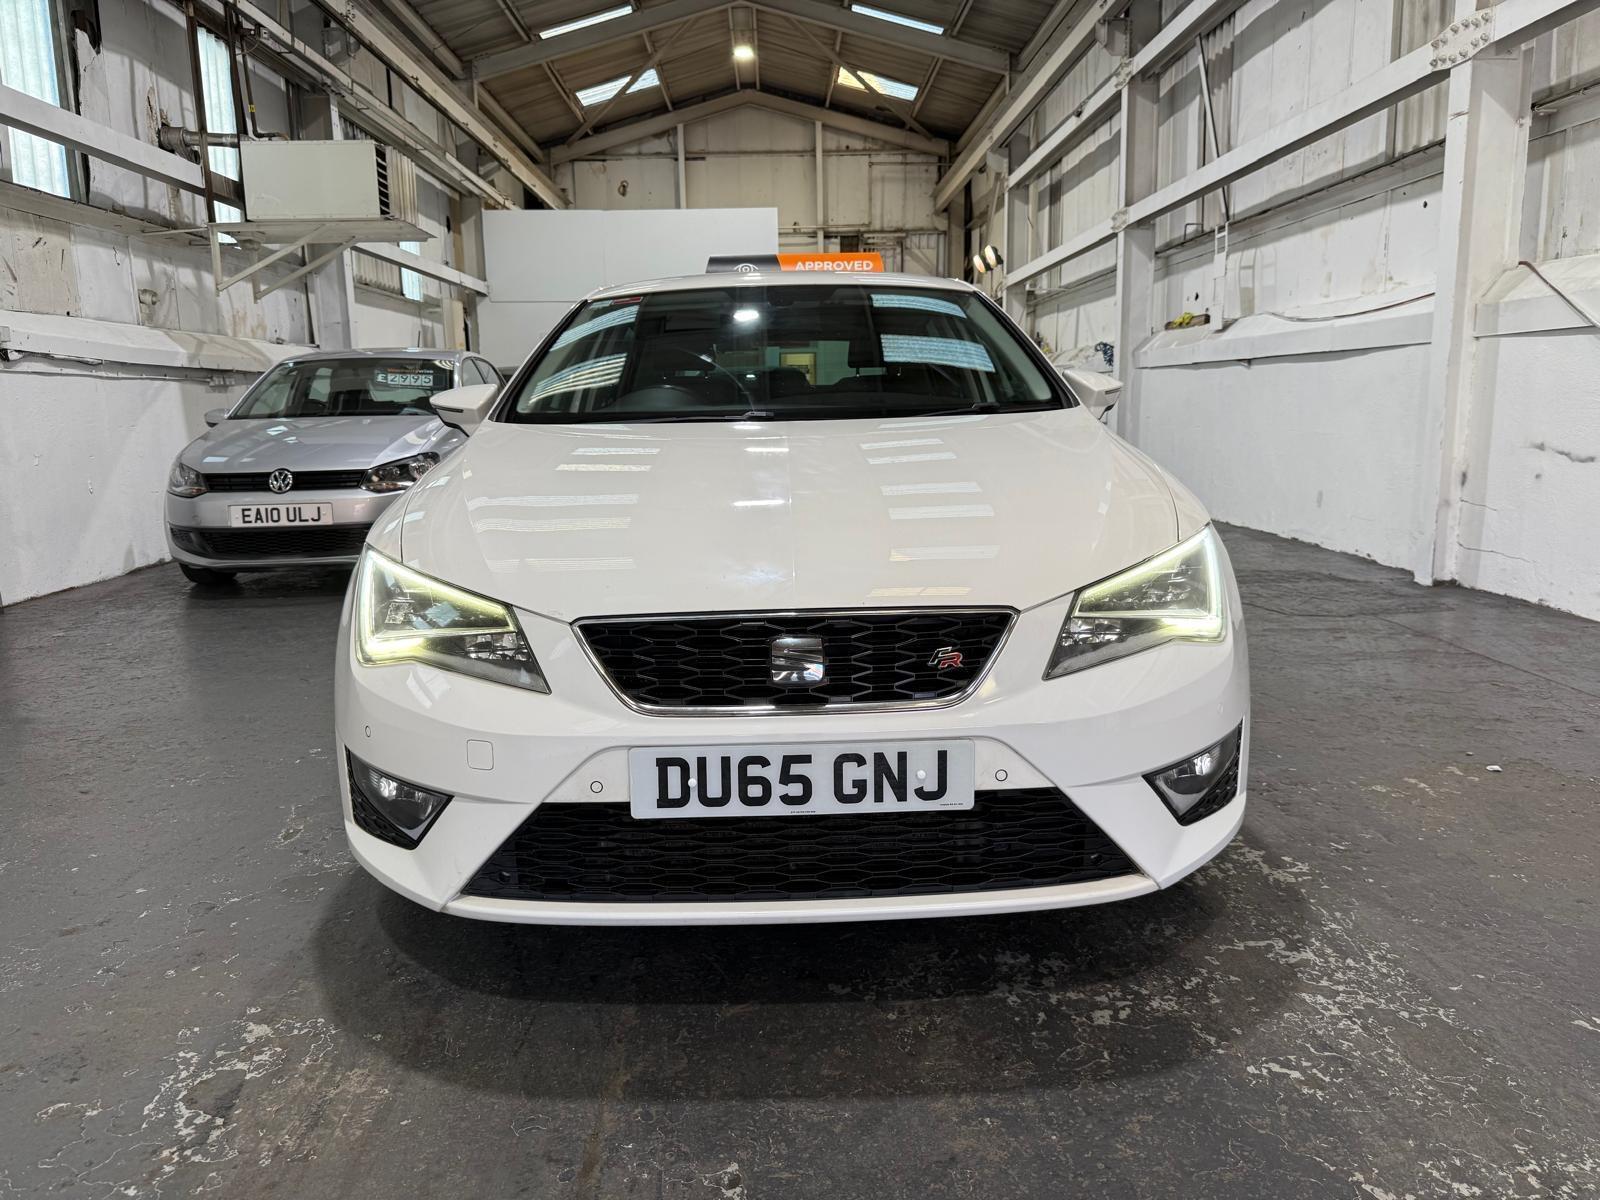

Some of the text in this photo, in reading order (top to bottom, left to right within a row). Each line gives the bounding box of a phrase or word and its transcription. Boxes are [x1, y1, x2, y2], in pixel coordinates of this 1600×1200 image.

[795, 260, 873, 272] APPROVED
[241, 506, 321, 524] EA10 ULJ
[928, 646, 963, 668] FR
[656, 750, 948, 809] DU65 GNJ
